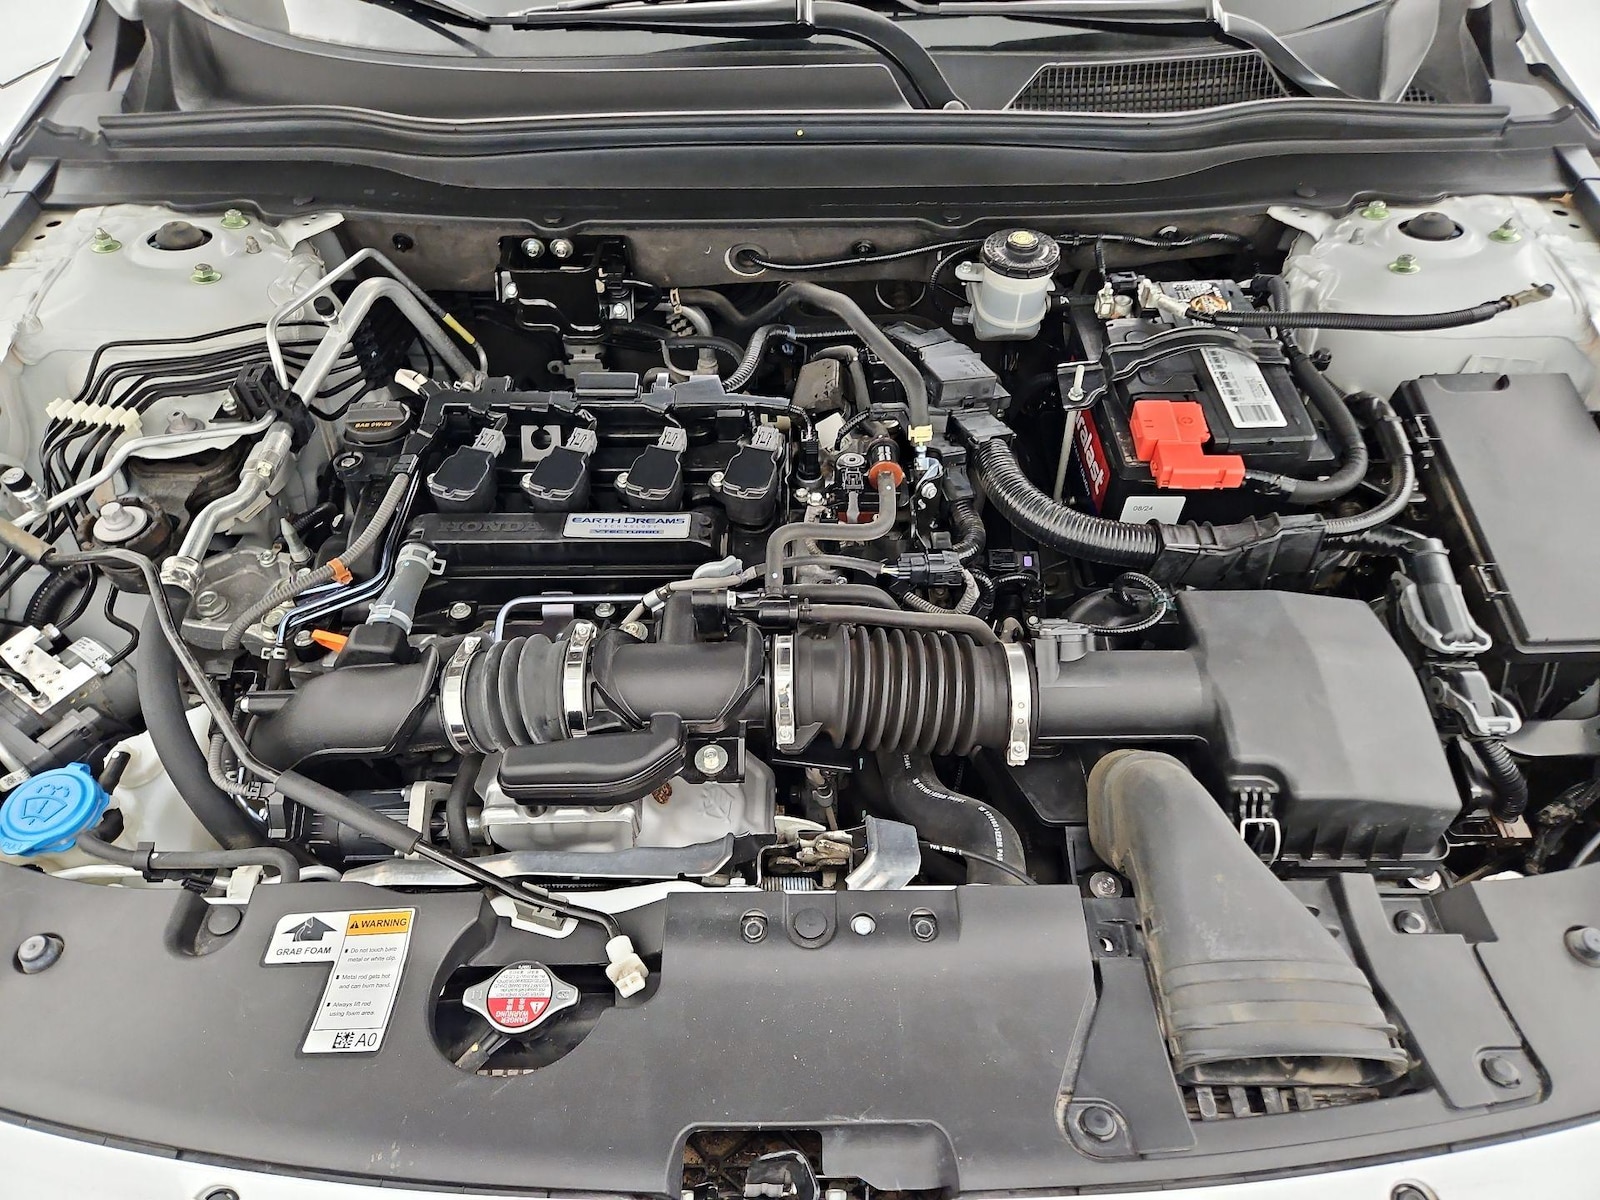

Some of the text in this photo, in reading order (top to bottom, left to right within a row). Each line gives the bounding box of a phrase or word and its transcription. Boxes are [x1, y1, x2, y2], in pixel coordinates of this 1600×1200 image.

[1076, 411, 1104, 495] ralast
[624, 516, 685, 524] DREAMS
[438, 520, 545, 532] HONDA
[361, 918, 407, 928] WARNING
[276, 946, 332, 955] GRAB FOAM
[355, 1032, 378, 1047] A0
